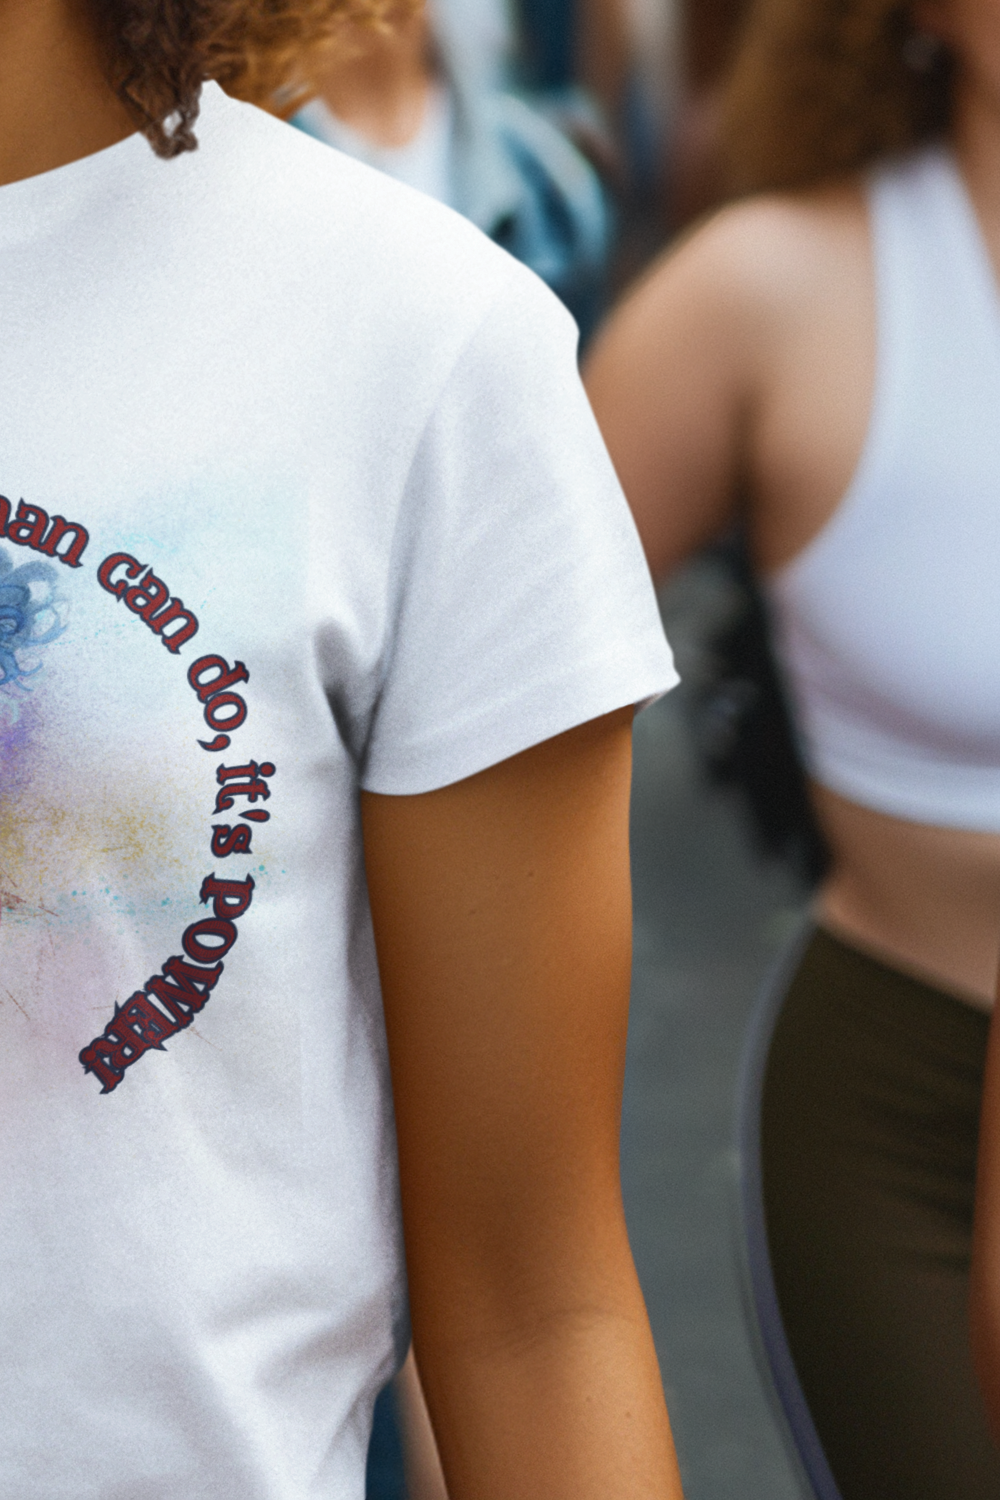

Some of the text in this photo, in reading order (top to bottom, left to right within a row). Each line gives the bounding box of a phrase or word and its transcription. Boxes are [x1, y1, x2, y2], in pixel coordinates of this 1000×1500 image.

[96, 552, 200, 654] can
[187, 653, 250, 752] do,
[211, 759, 276, 858] it's
[78, 872, 256, 1095] POWER!
